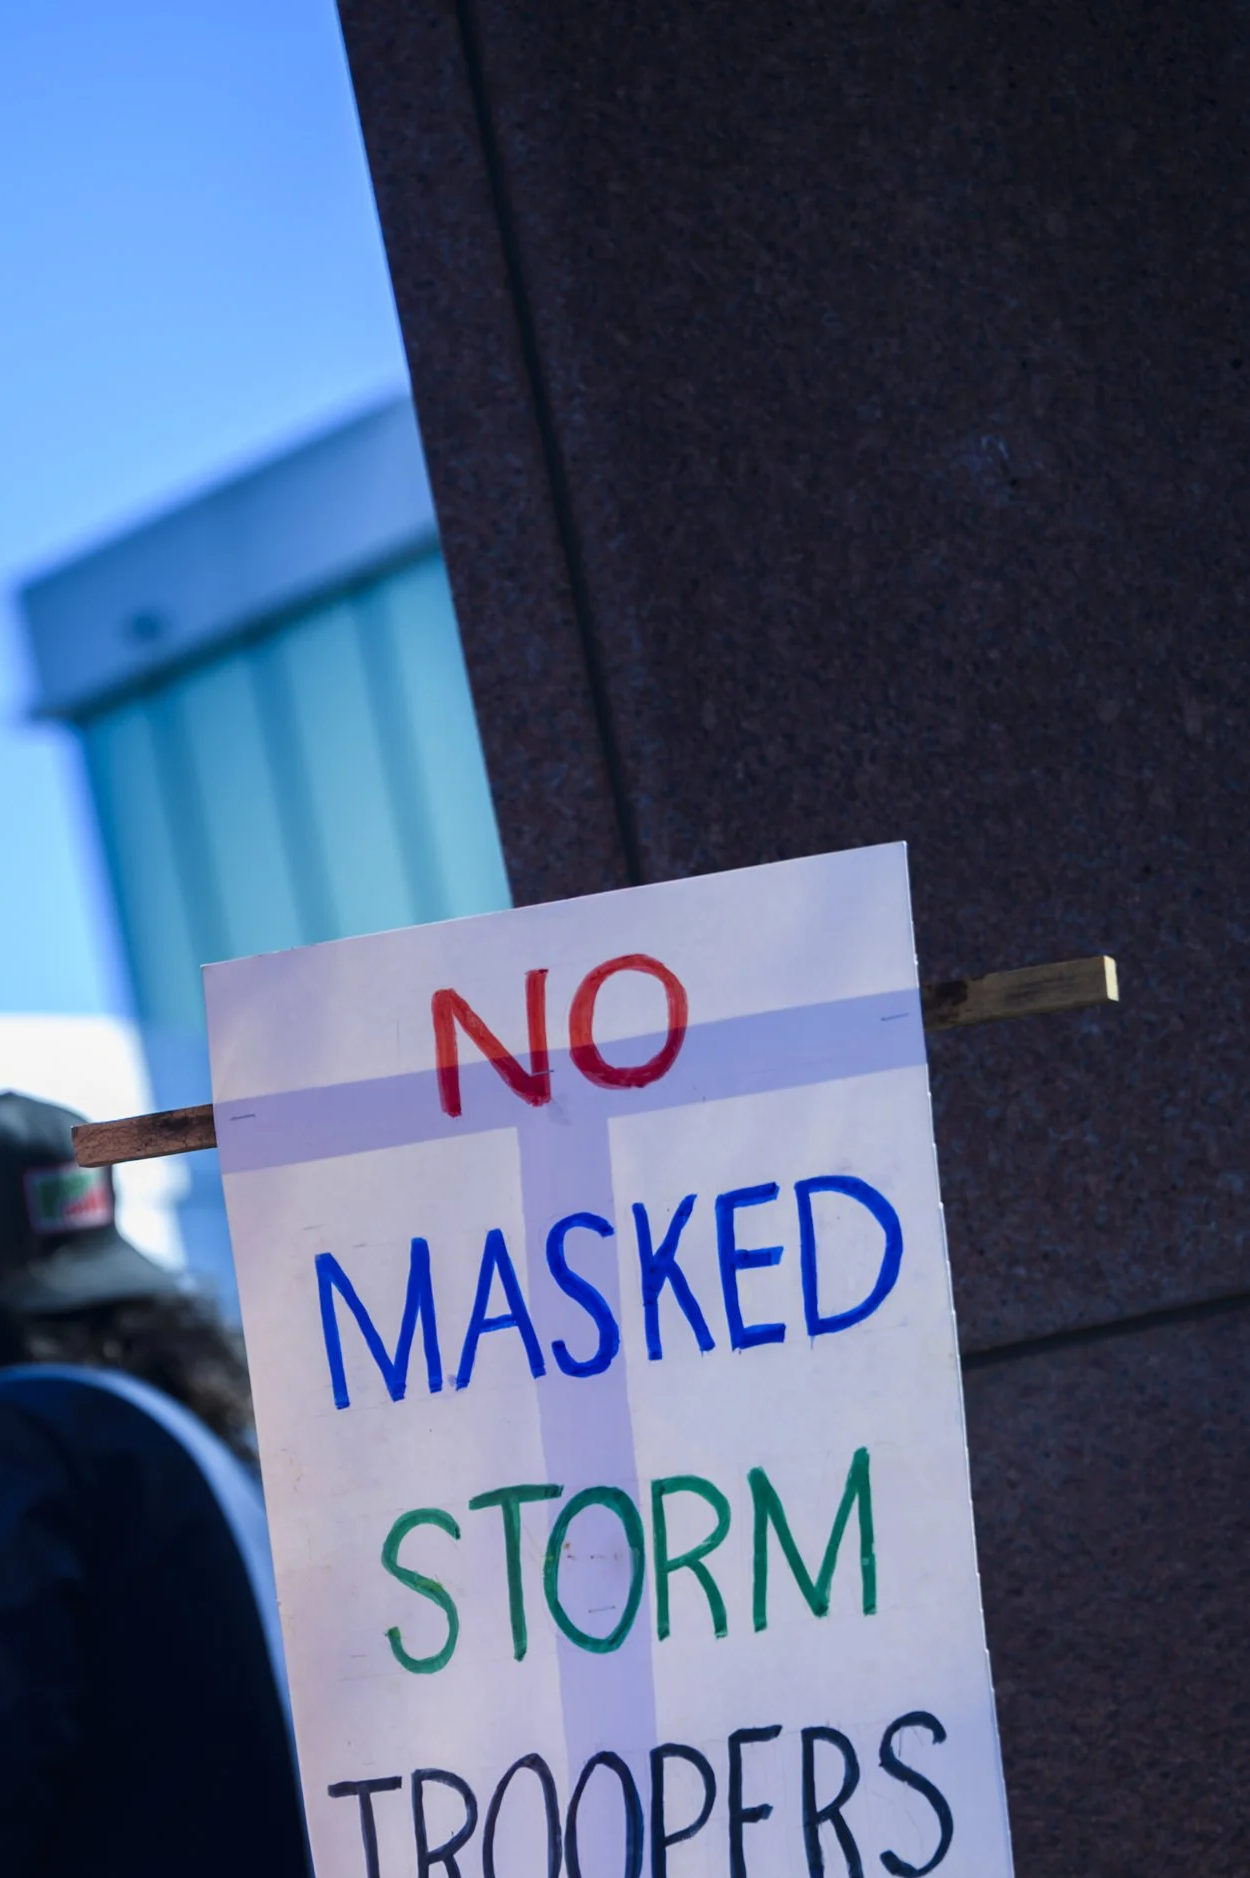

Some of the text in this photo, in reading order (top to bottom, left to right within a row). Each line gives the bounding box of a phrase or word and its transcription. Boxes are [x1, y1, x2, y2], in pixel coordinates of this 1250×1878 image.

[431, 953, 689, 1118] NO
[315, 1174, 905, 1410] MASKED
[381, 1446, 878, 1676] STORM
